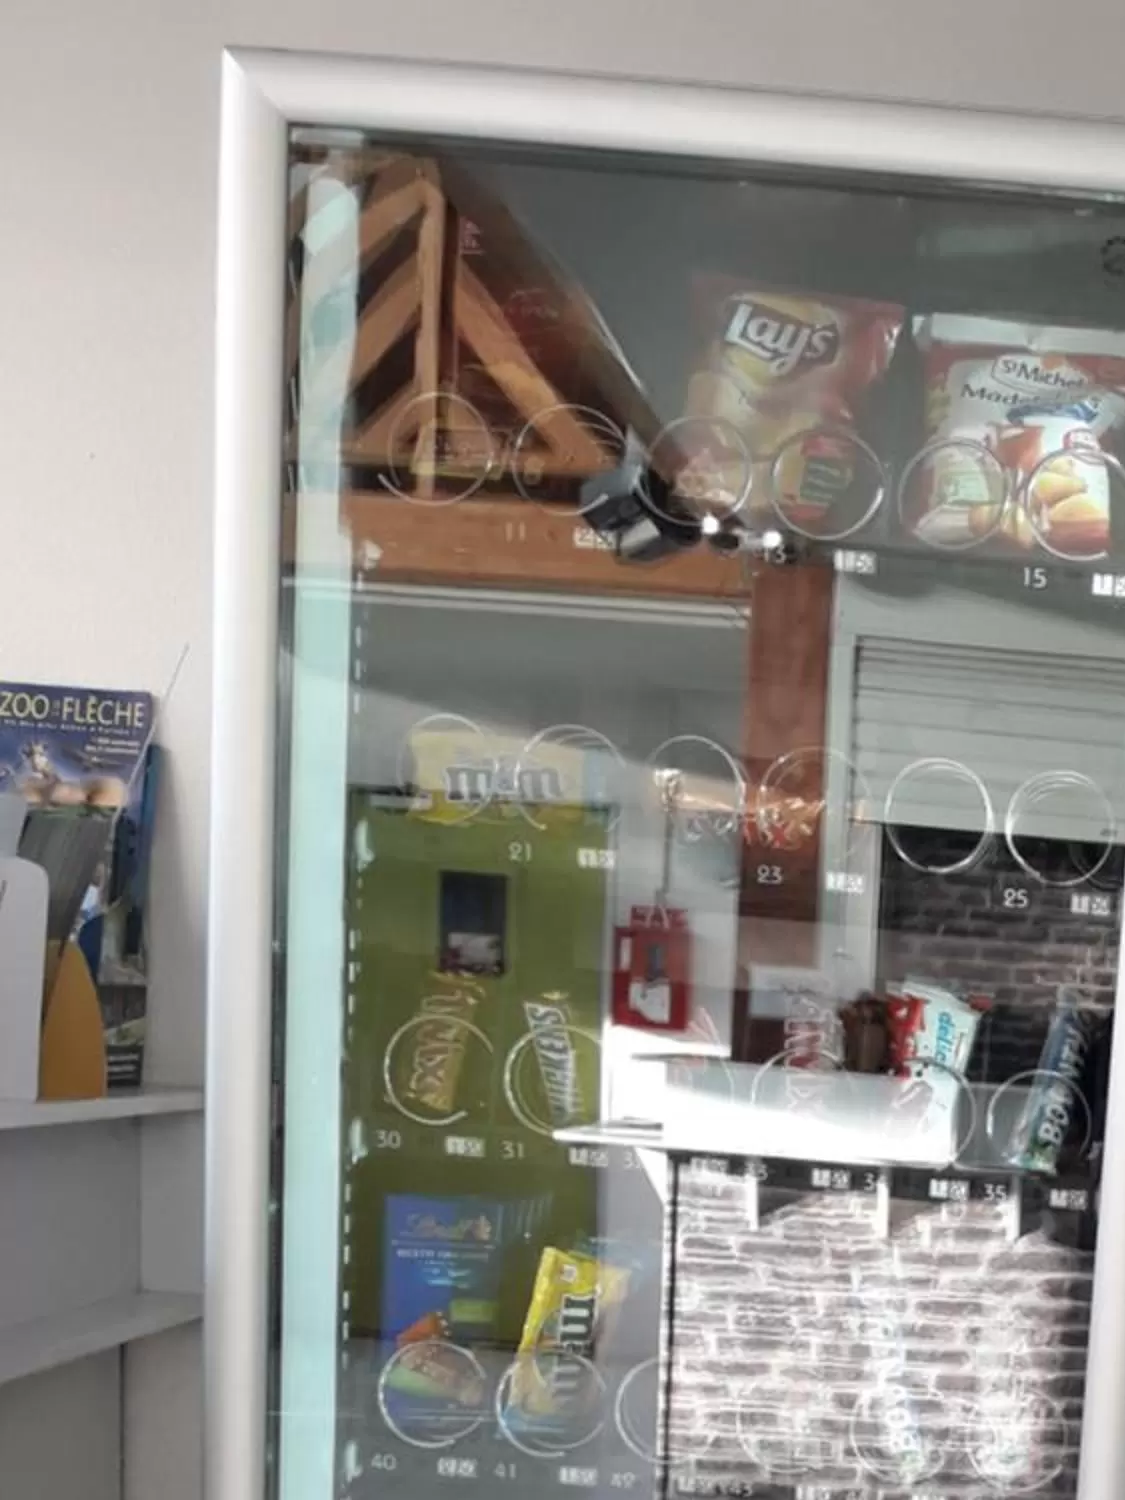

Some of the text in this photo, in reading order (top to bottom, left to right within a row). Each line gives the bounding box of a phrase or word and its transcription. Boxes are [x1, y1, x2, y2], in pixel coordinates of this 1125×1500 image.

[724, 303, 836, 376] Lay's
[1023, 566, 1047, 588] 15
[0, 691, 49, 719] ZOO
[508, 841, 532, 862] 21
[757, 865, 783, 884] 23
[1003, 888, 1029, 908] 25
[375, 1130, 401, 1149] 30
[502, 1141, 525, 1160] 31
[984, 1184, 1007, 1202] 35
[371, 1453, 397, 1470] 40
[494, 1462, 517, 1479] 41
